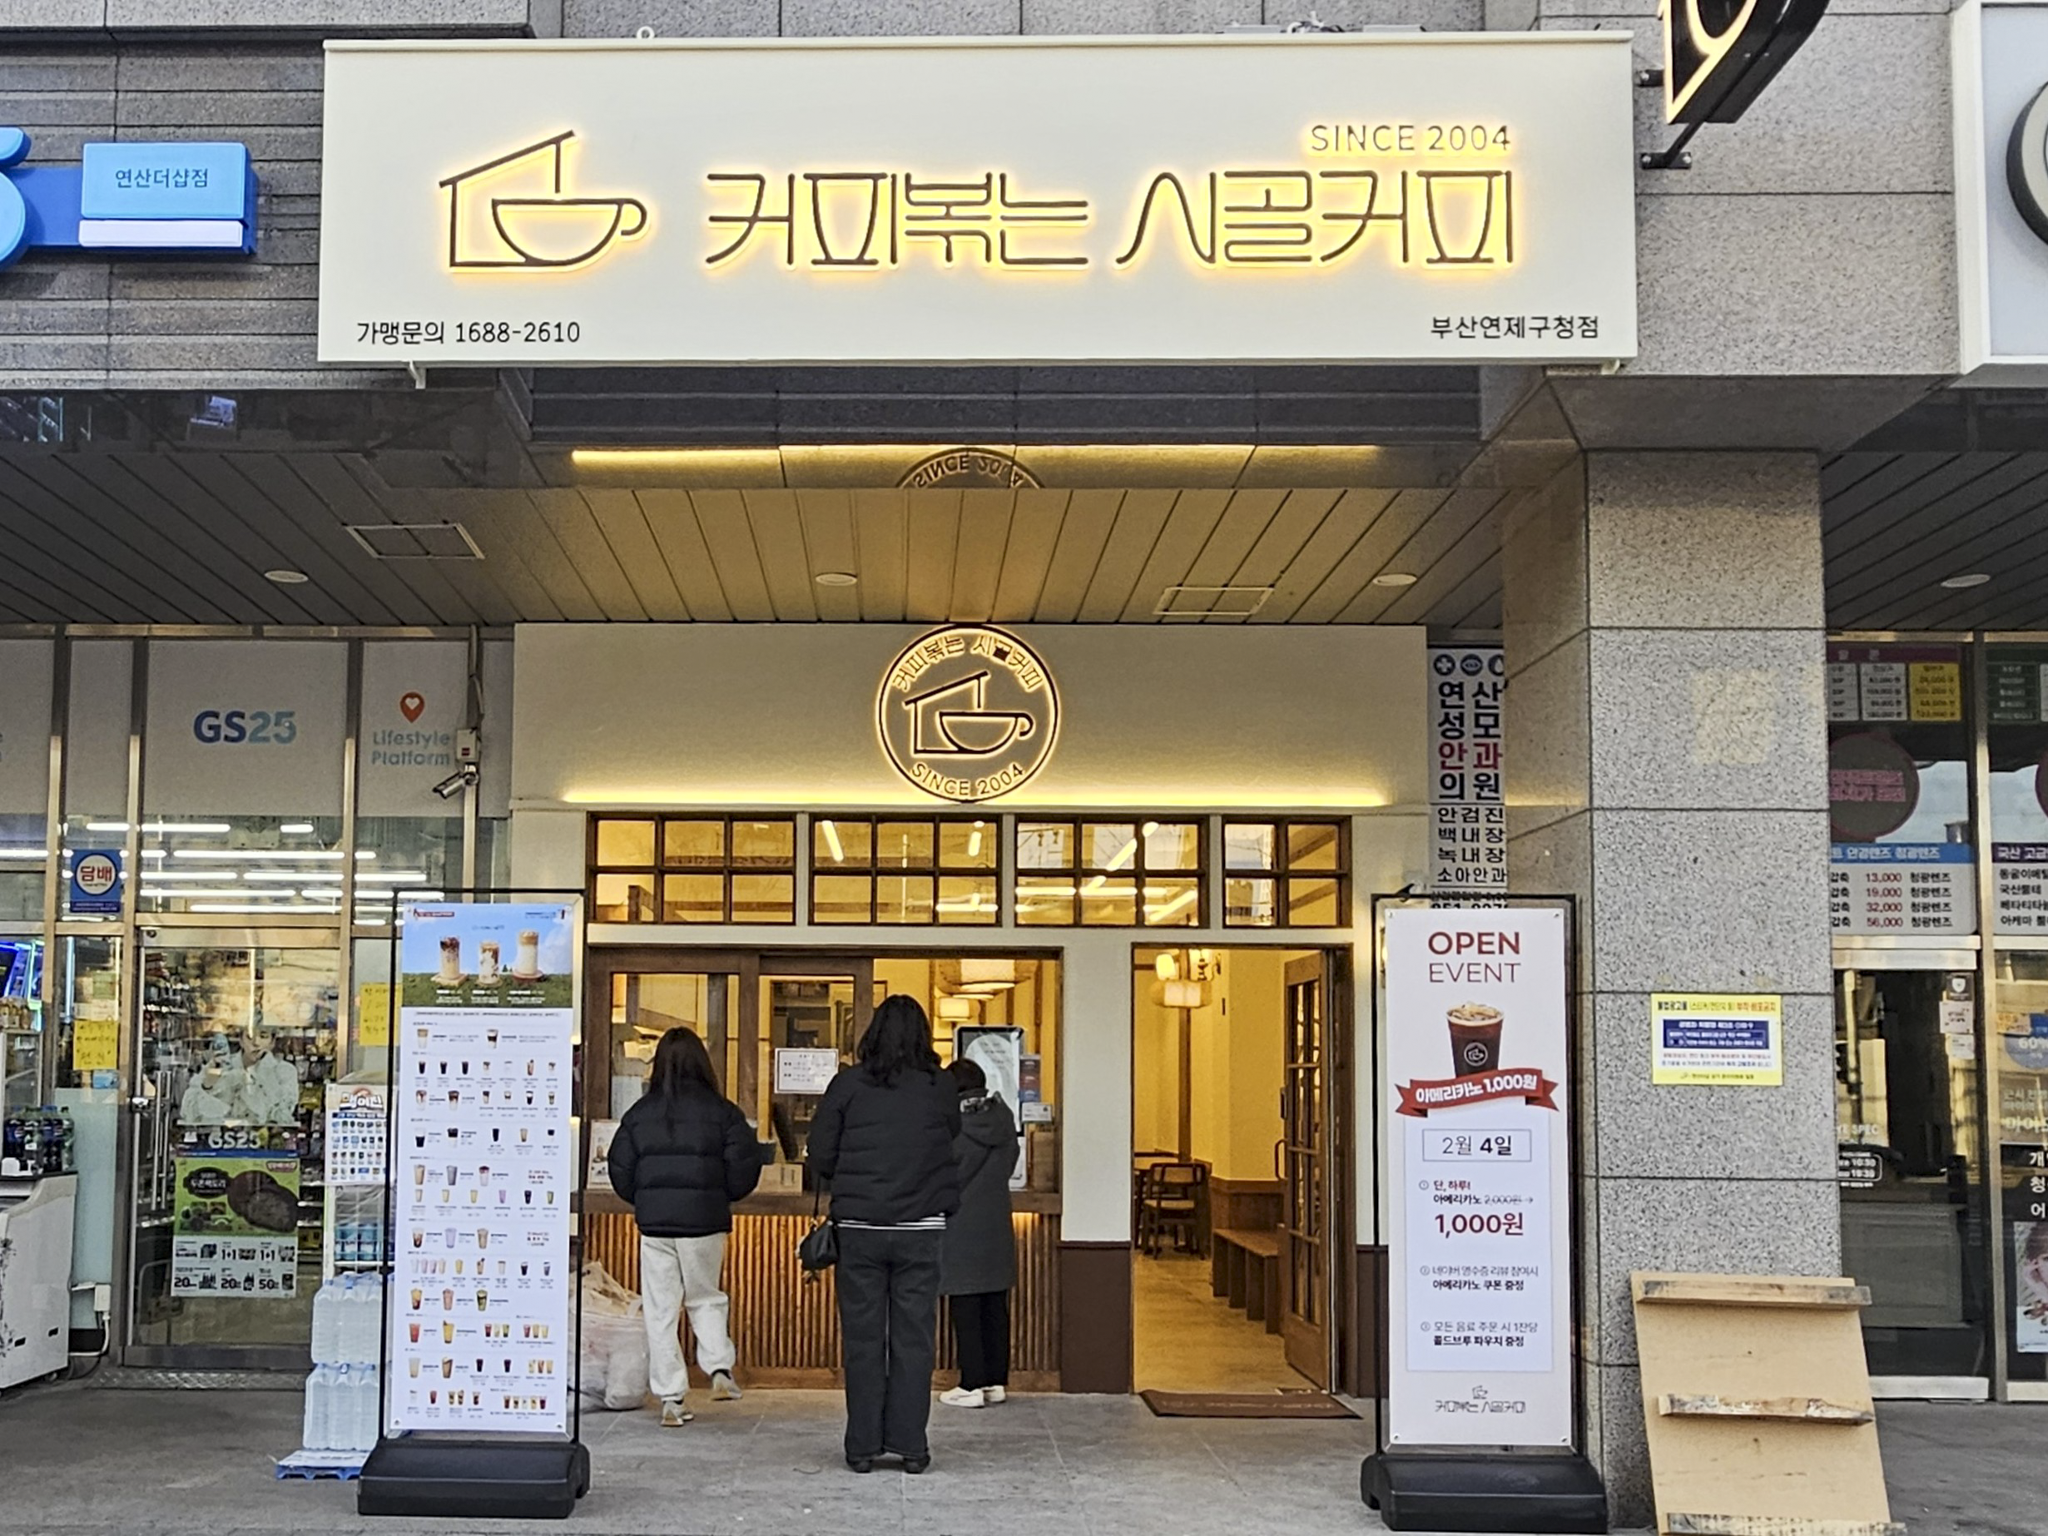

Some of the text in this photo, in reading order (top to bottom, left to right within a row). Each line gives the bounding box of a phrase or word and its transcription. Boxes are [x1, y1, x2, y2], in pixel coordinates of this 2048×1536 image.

[1310, 125, 1512, 152] SINCE 2004
[115, 168, 209, 189] 연산더샵점
[705, 170, 1514, 266] 커피볶는 시골커피
[356, 320, 581, 346] 가맹문의 1688-2610
[1431, 315, 1600, 340] 부산연제구청점
[892, 635, 1044, 692] 커피볶는 시골커피
[1438, 681, 1503, 711] 연산
[193, 709, 298, 745] GS25
[1438, 711, 1502, 741] 성모
[372, 730, 451, 748] Lifestyle
[371, 749, 451, 767] Platform
[1438, 742, 1504, 771] 안과
[911, 763, 1025, 797] SINCE 2004
[1439, 772, 1501, 801] 의원
[1438, 806, 1504, 824] 안검진
[1438, 826, 1505, 844] 백내장
[1438, 847, 1505, 864] 녹내장
[80, 865, 113, 882] 담배
[1437, 866, 1508, 884] 소아안과
[1866, 872, 1903, 883] 13,000
[1866, 902, 1903, 913] 32,000
[1427, 931, 1520, 955] OPEN
[1428, 962, 1522, 984] EVENT
[1415, 1074, 1538, 1104] 아메리카노 1,000원
[1442, 1135, 1513, 1157] 2월 4일
[1433, 1193, 1482, 1206] 아메리카노
[1434, 1212, 1524, 1240] 1,000원
[1432, 1265, 1461, 1277] 네이버
[1461, 1265, 1490, 1278] 영수증
[1432, 1279, 1525, 1291] 아메리카노 쿠폰 증정
[1433, 1321, 1454, 1333] 모든
[1456, 1321, 1476, 1333] 음료
[1478, 1321, 1499, 1333] 주문
[1501, 1321, 1512, 1333] 시
[1513, 1322, 1539, 1334] 1잔당
[1433, 1334, 1525, 1348] 콜드브루 파우치 증정
